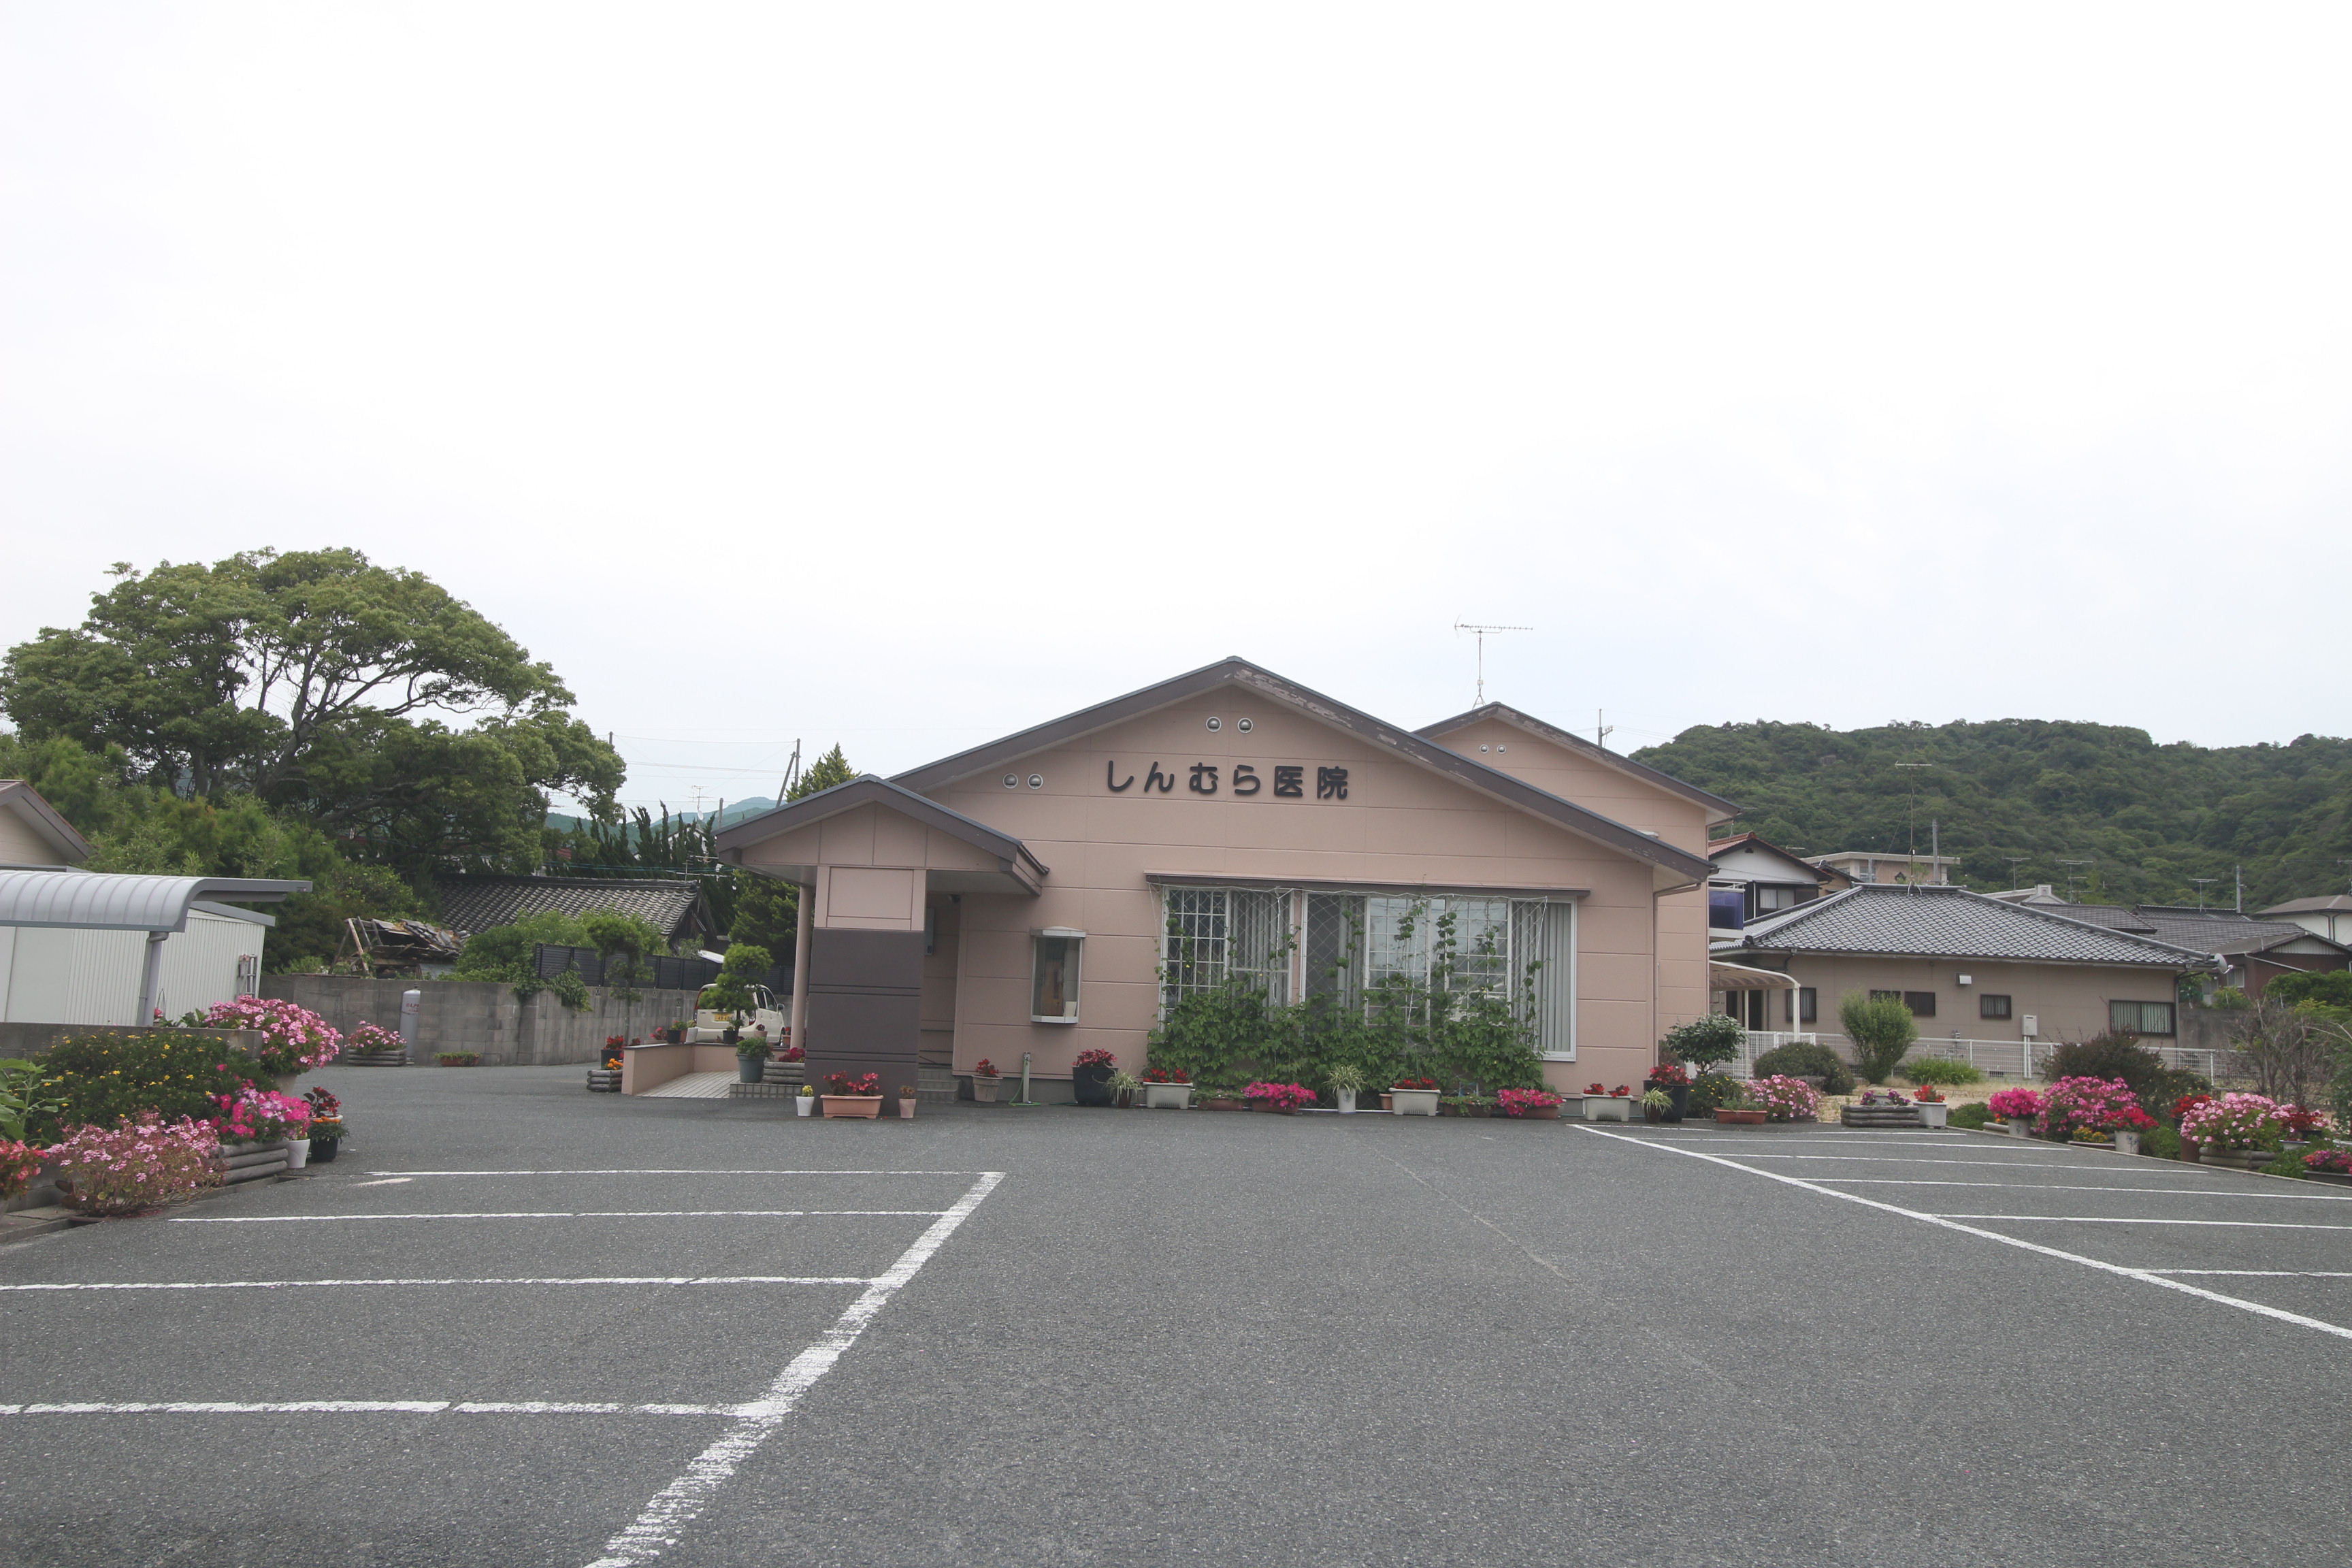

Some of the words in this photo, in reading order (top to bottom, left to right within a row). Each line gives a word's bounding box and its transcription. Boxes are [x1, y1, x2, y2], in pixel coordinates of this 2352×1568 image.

[1107, 760, 1349, 800] しんむら医院
